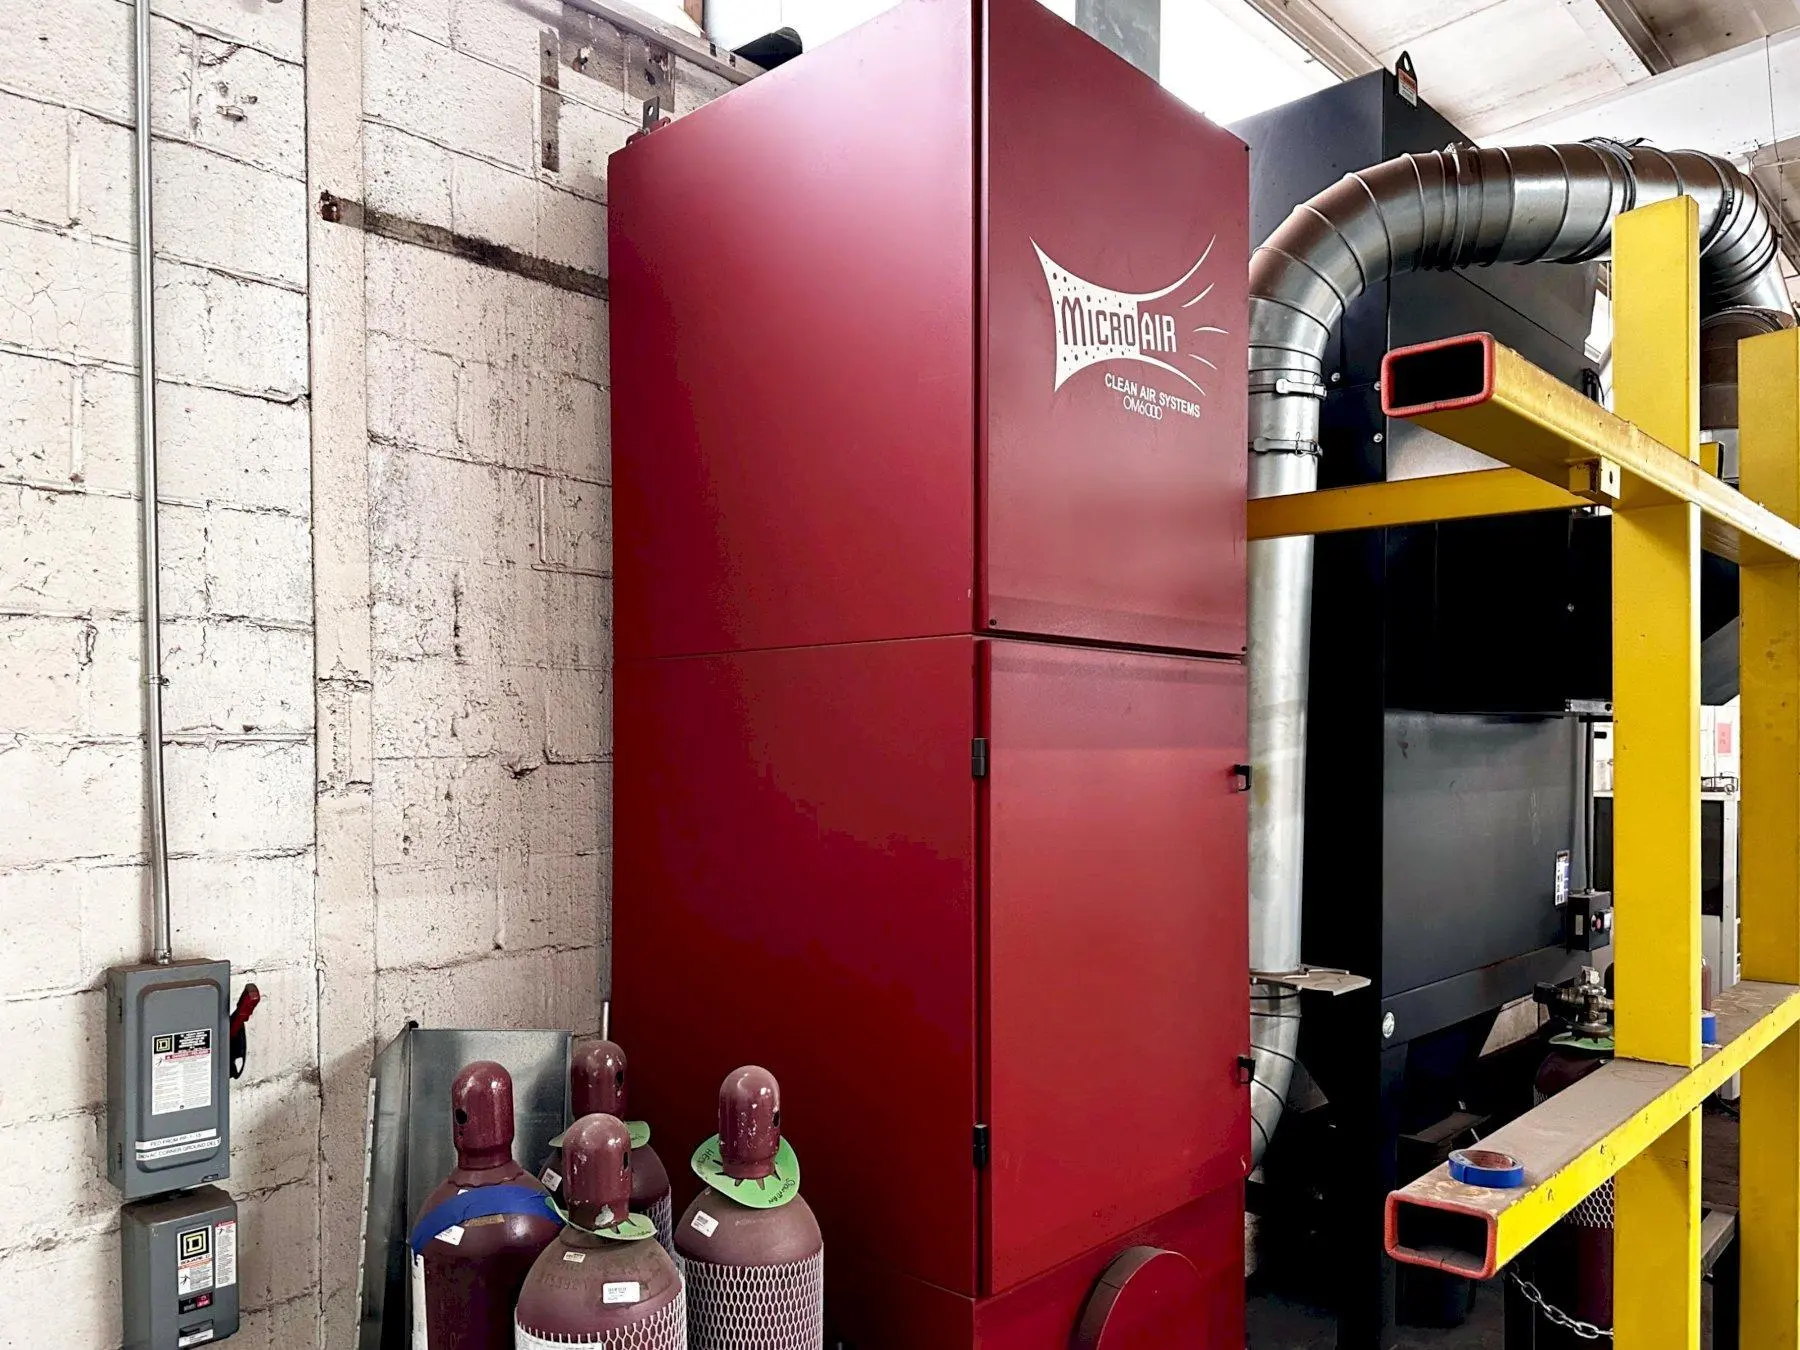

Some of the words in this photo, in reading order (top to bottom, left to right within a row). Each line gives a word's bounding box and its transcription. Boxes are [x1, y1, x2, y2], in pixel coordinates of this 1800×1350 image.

[1105, 373, 1137, 397] CLEAN
[1139, 386, 1157, 403] AIR
[1159, 391, 1201, 418] SYSTEMS
[1123, 395, 1163, 420] OM6000
[158, 1146, 182, 1156] CORNER
[183, 1142, 206, 1152] GROUND
[162, 1135, 178, 1144] FROM
